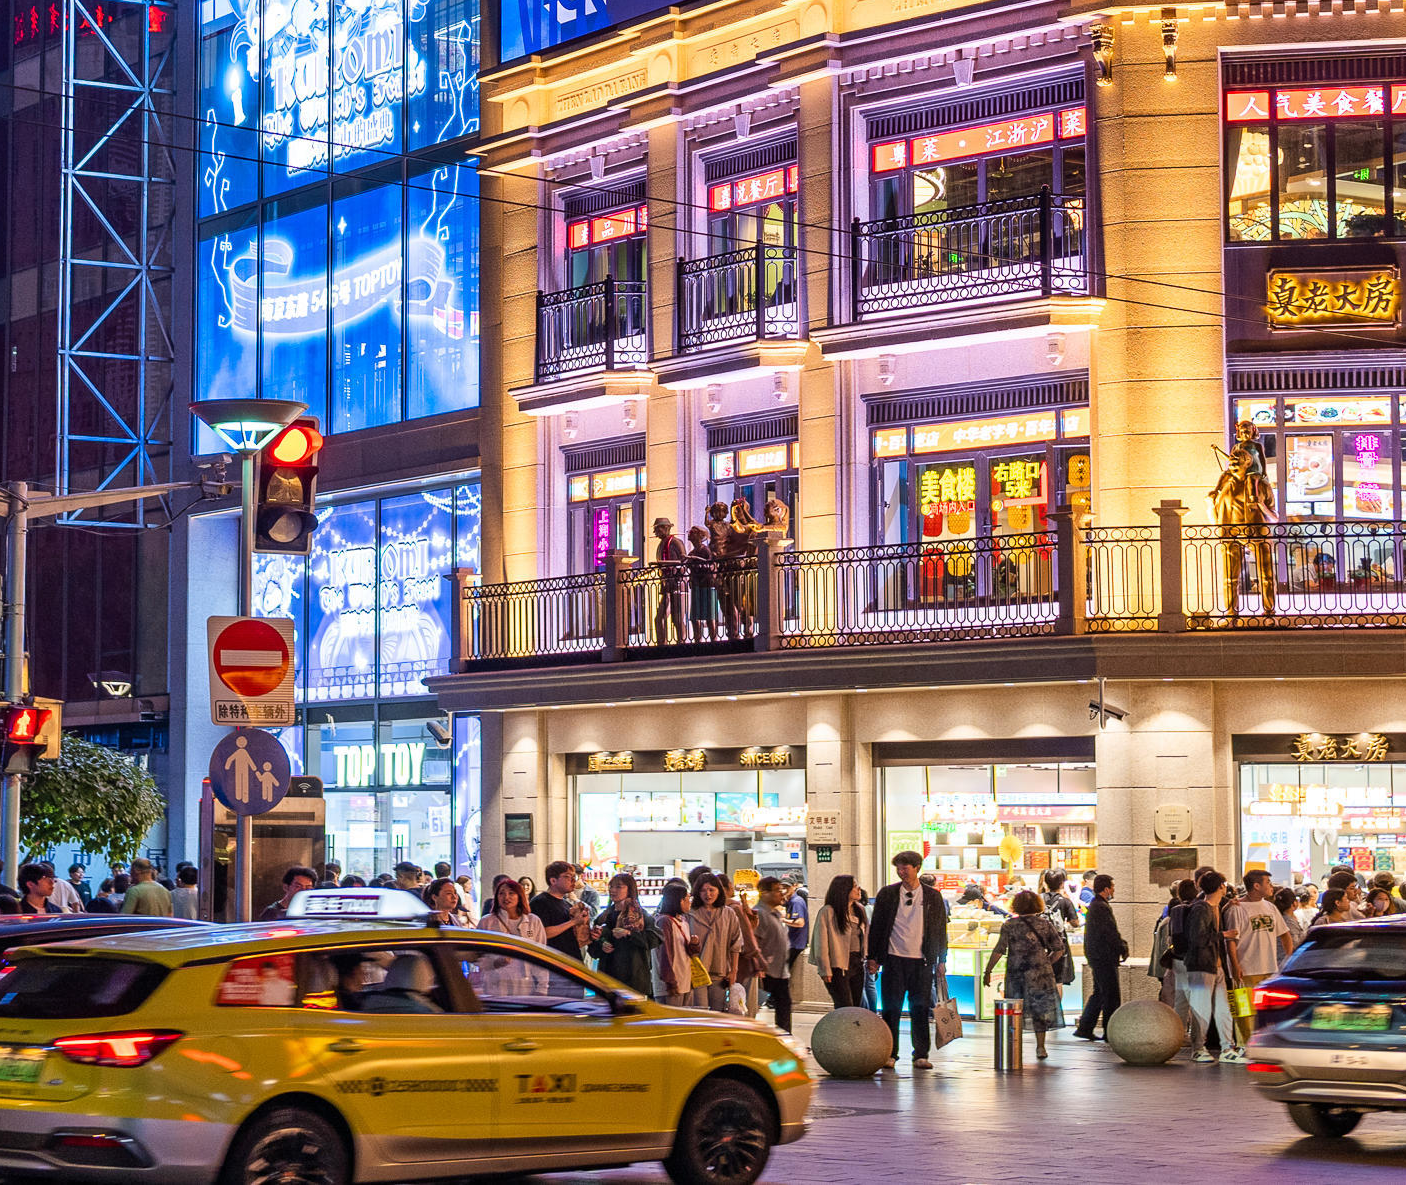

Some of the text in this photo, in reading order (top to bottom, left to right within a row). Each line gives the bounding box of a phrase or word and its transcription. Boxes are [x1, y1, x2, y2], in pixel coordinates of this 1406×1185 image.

[1272, 275, 1396, 317] 真老大房
[993, 460, 1040, 482] 右路口
[921, 468, 976, 503] 美食楼
[1005, 480, 1032, 498] 5米
[218, 703, 287, 720] 除特种车辆外
[1291, 733, 1389, 762] 真老大房
[333, 742, 428, 789] TOP TOY
[809, 816, 837, 825] 文明单位
[513, 1073, 578, 1094] TAXI
